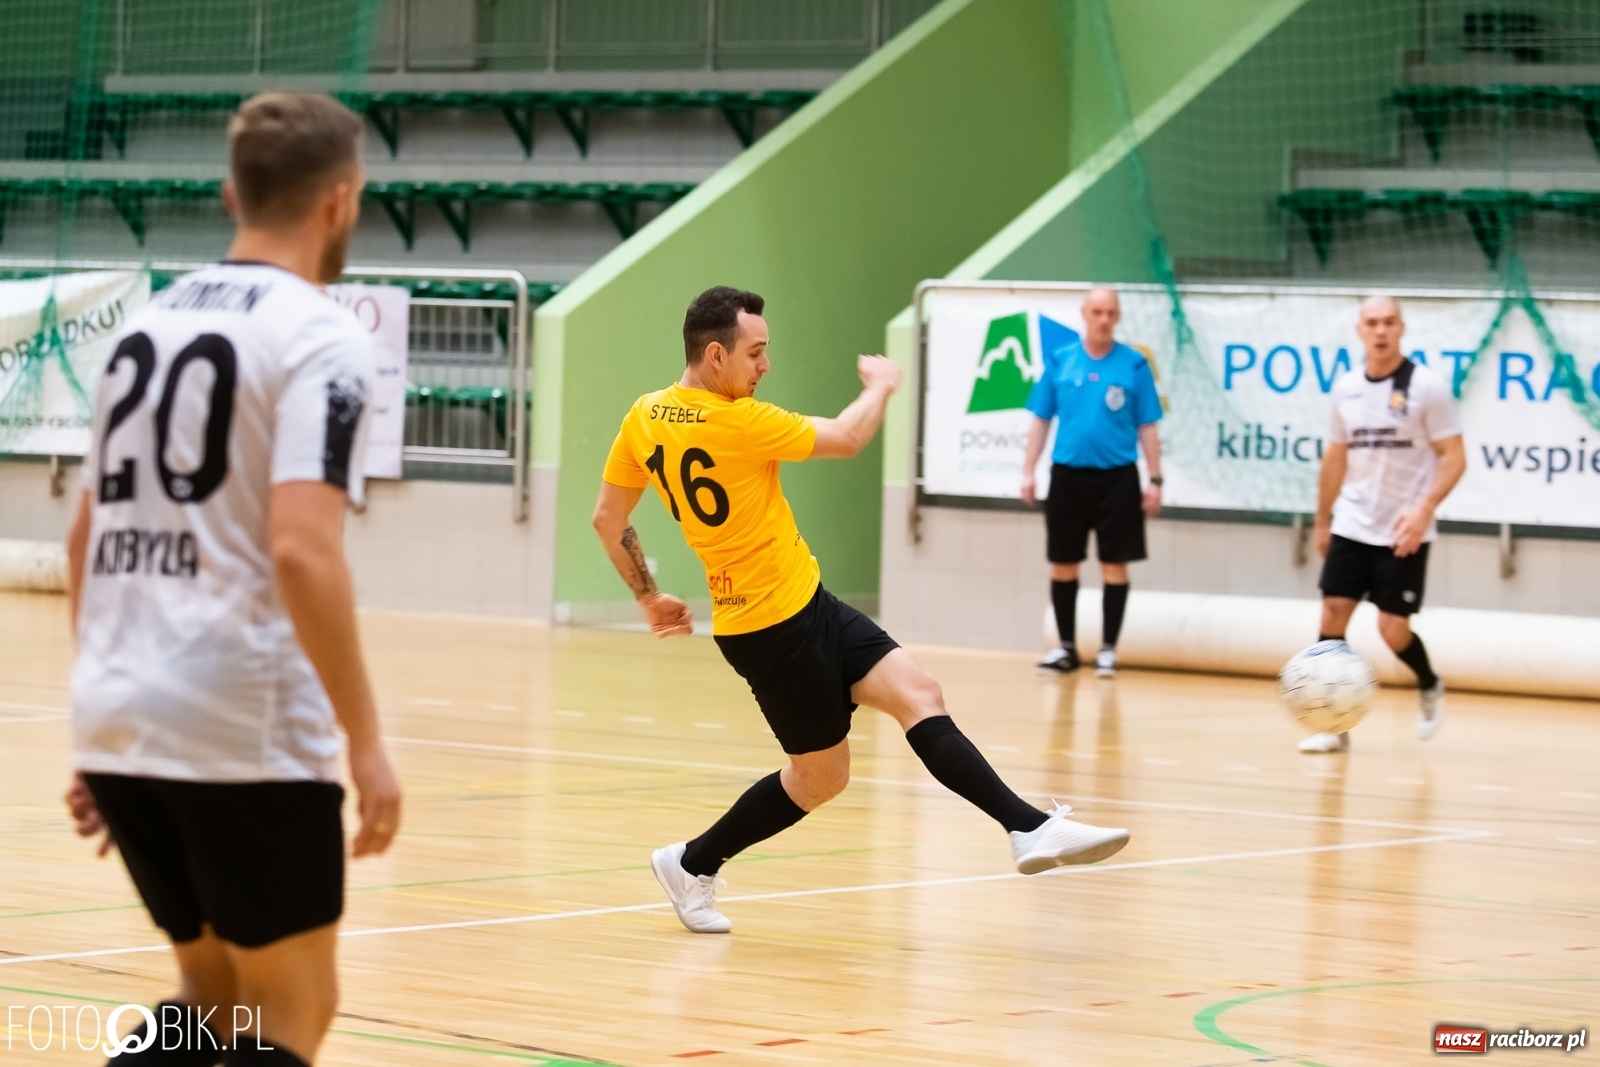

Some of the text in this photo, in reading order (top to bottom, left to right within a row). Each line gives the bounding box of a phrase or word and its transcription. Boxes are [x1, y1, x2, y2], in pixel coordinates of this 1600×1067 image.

[97, 331, 238, 504] 20
[650, 404, 707, 423] STEBEL
[645, 444, 730, 527] 16
